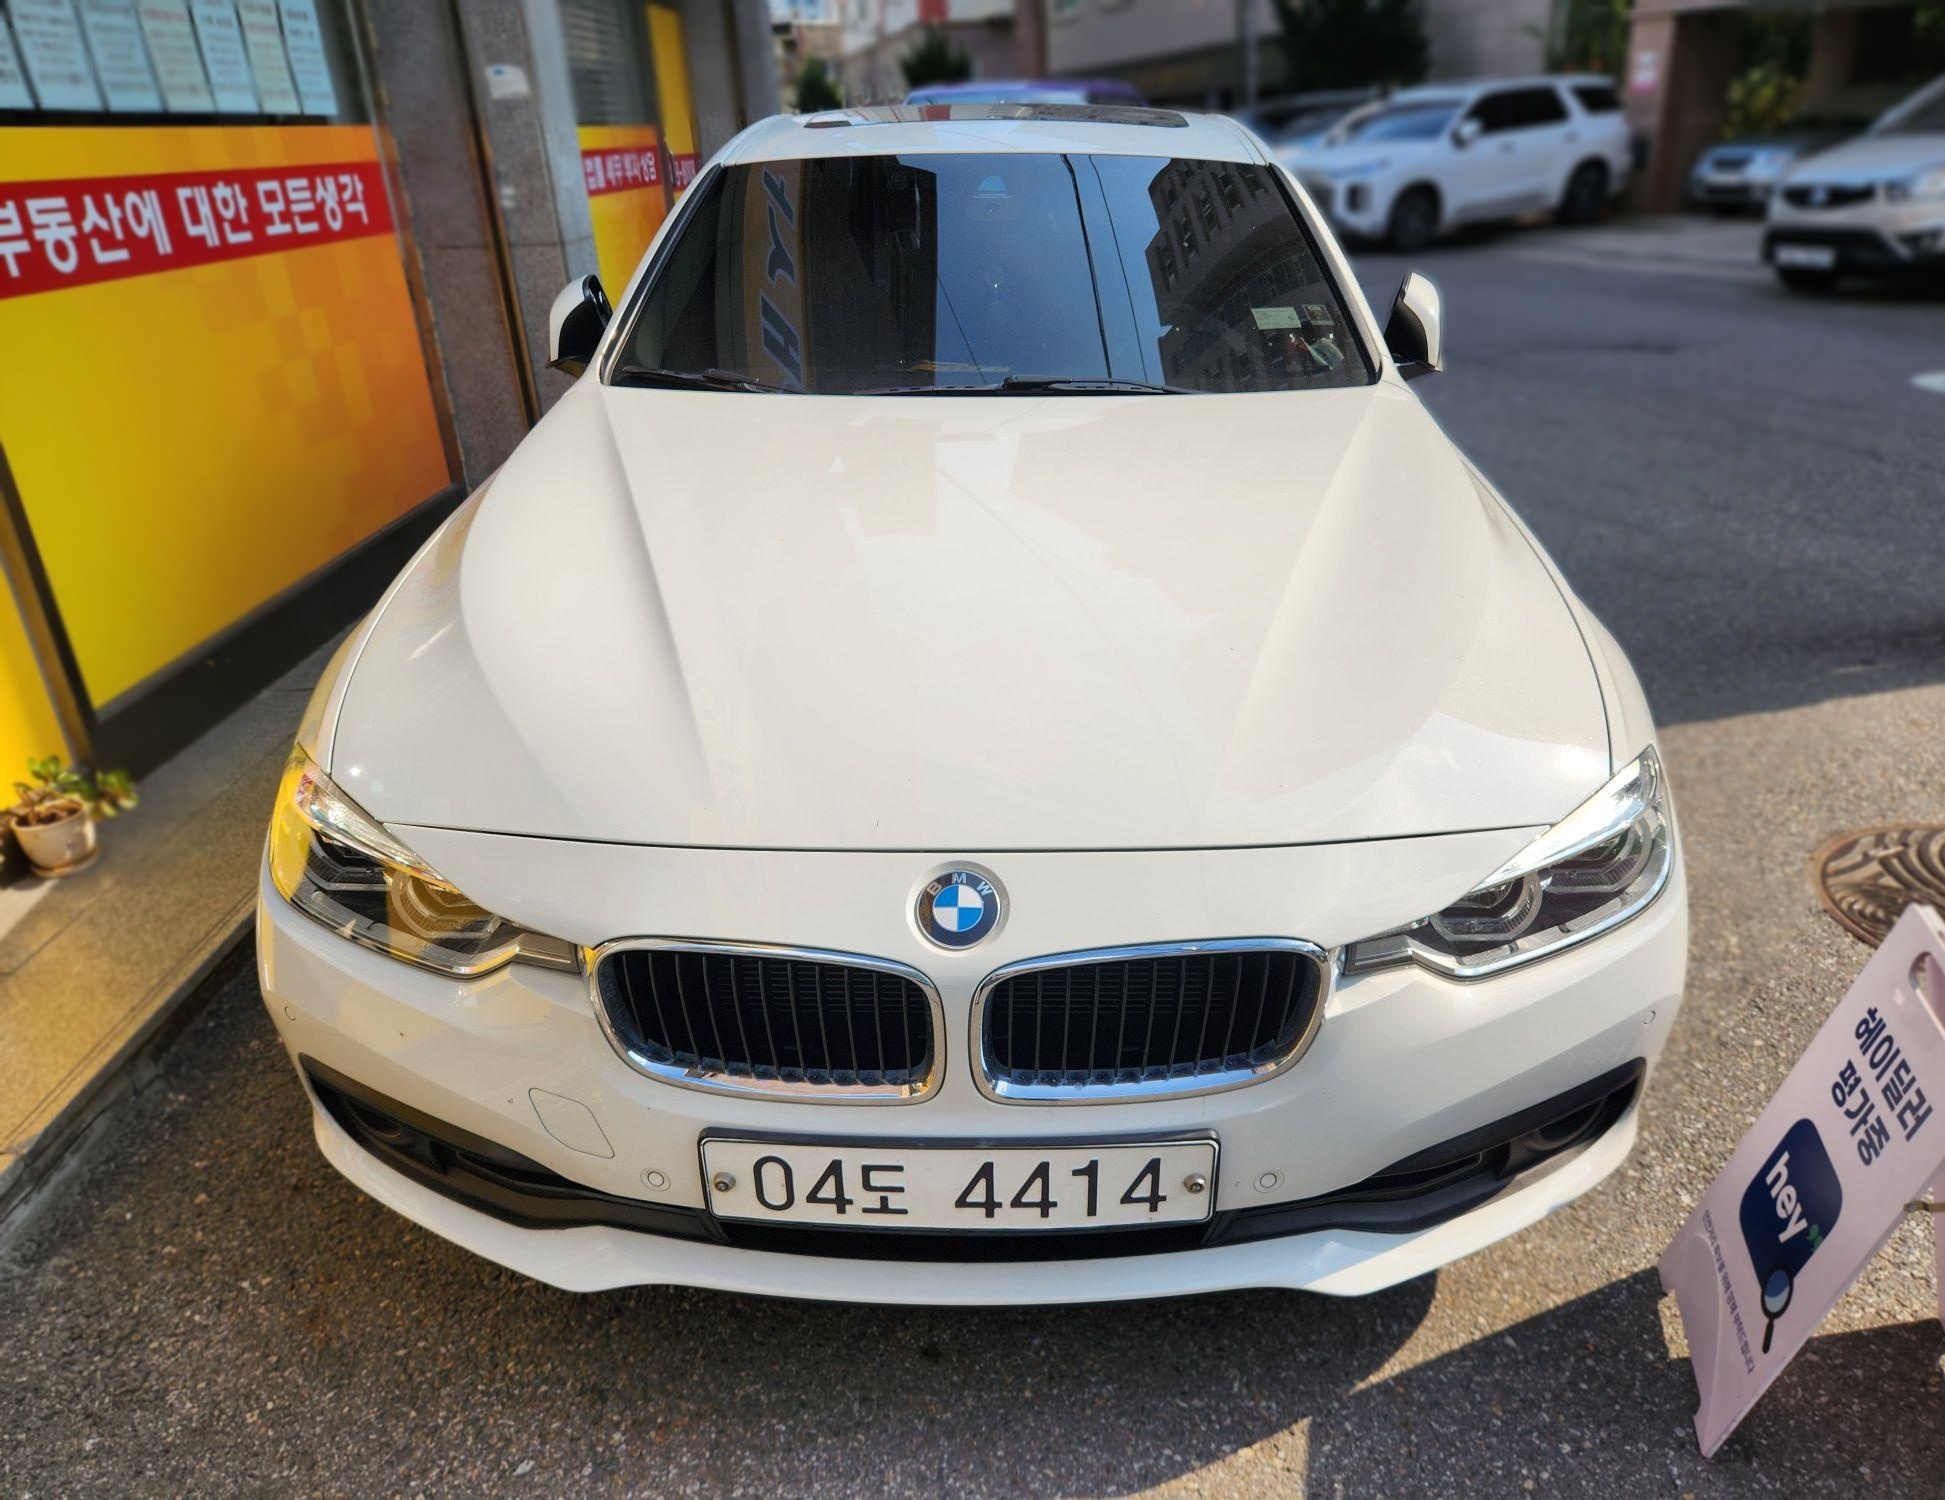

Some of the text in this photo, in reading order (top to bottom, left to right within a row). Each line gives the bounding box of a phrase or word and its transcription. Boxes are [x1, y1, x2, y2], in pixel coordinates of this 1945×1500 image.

[0, 173, 369, 278] 부동산에 대한 모든생각
[927, 872, 993, 897] BMW
[1831, 1059, 1891, 1166] 평가중
[1855, 1007, 1934, 1143] 헤이딜러
[752, 1155, 1167, 1218] 04도 4414
[1765, 1151, 1808, 1243] hey
